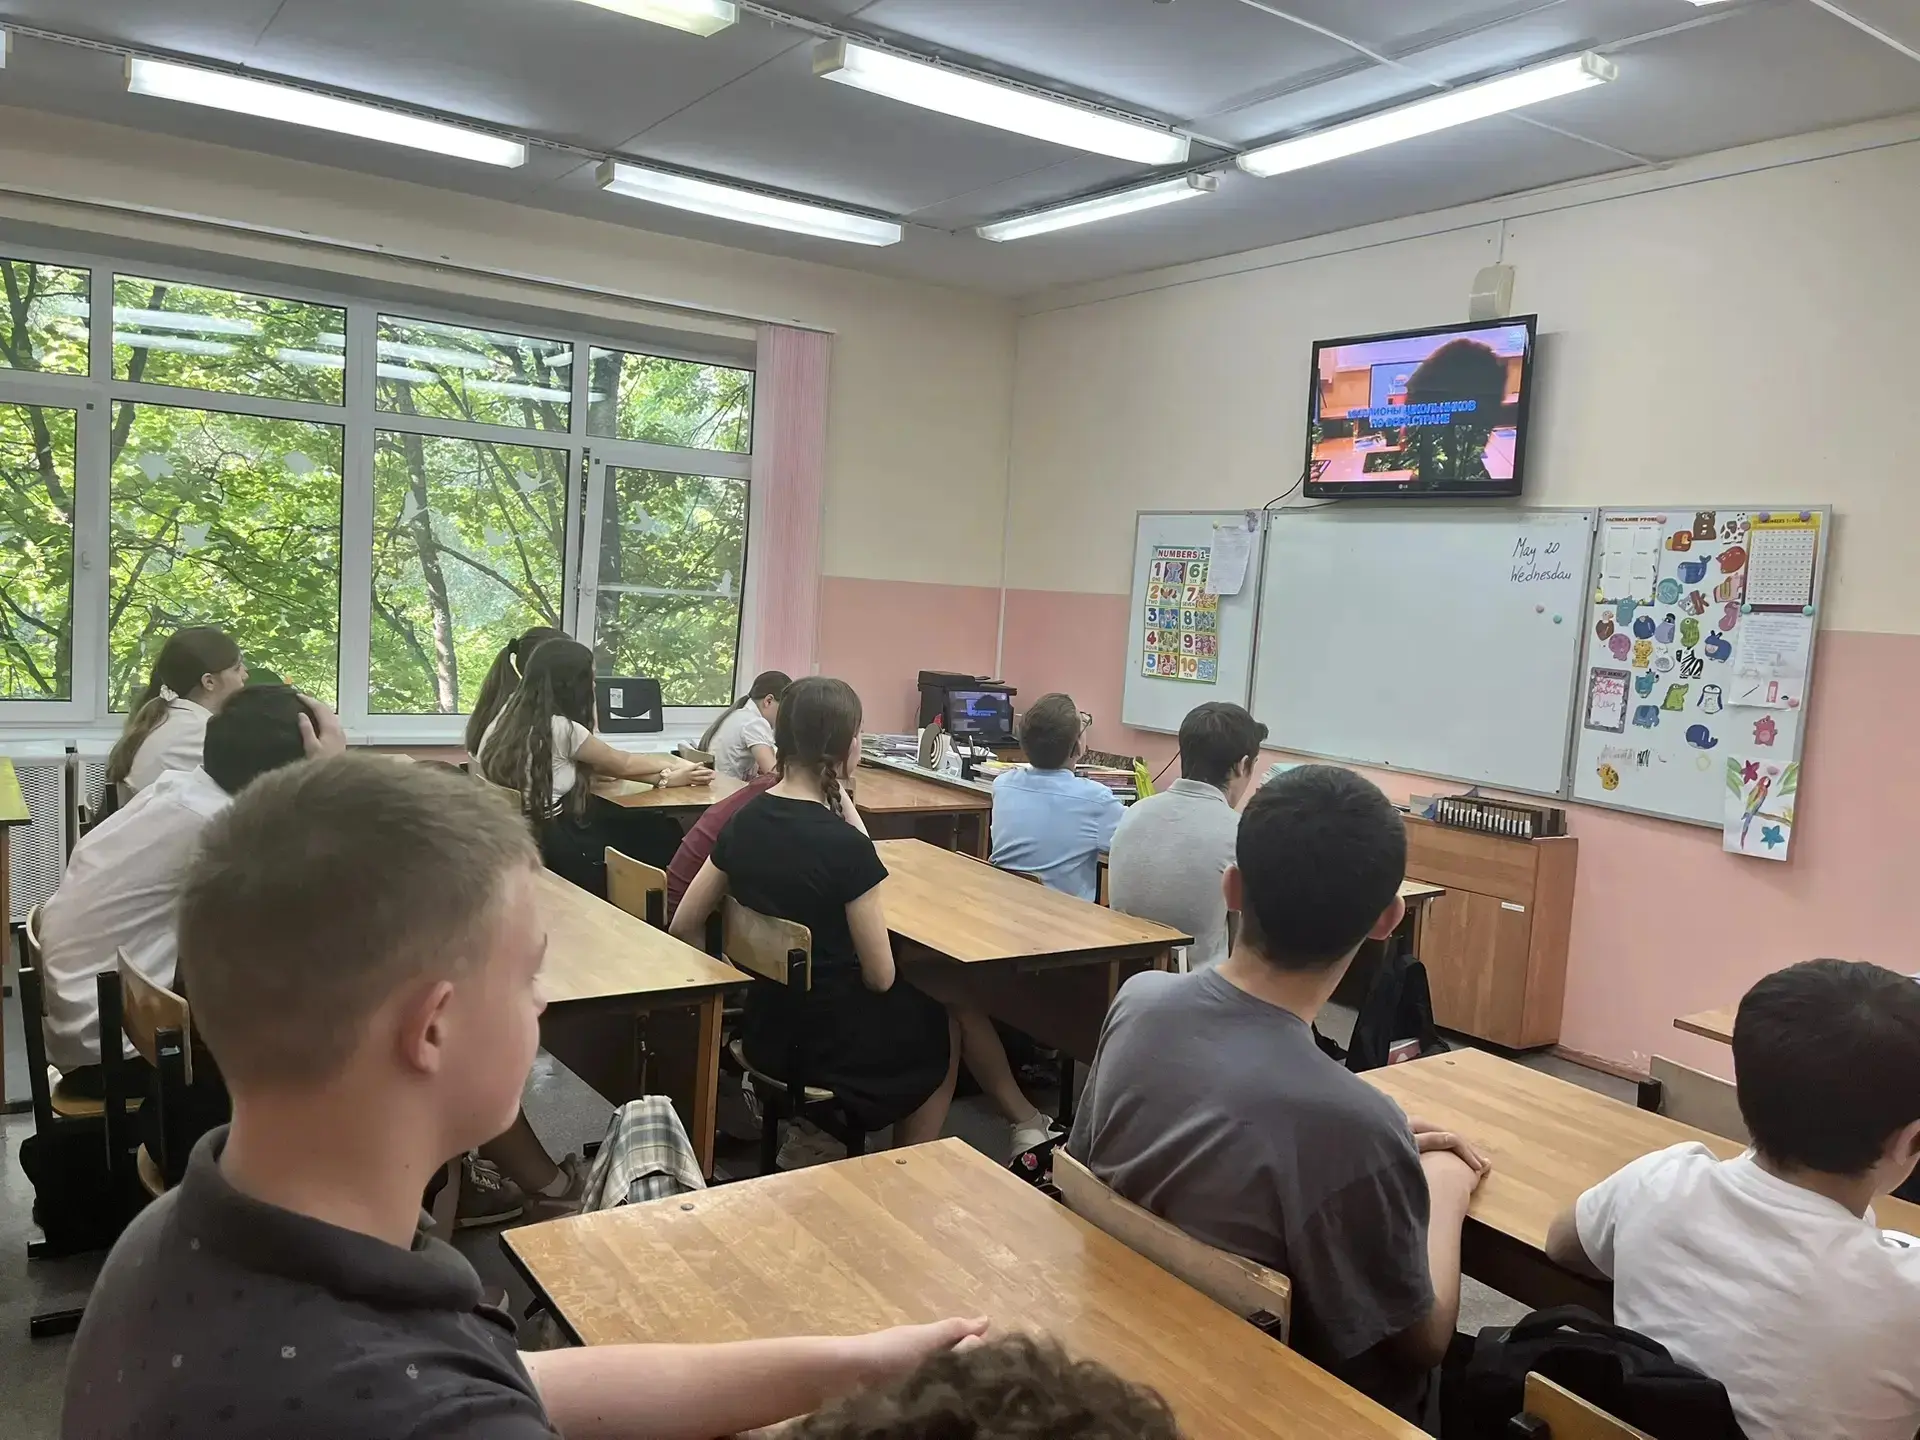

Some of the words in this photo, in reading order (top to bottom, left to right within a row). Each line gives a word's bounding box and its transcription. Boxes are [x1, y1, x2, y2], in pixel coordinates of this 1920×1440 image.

[1405, 400, 1477, 416] ШКОЛЬНИКОВ
[1410, 413, 1450, 426] СТРАНЕ
[1158, 550, 1198, 559] NUMBERS
[1512, 537, 1536, 566] May
[1544, 542, 1560, 554] 20
[1154, 562, 1161, 576] 1
[1189, 563, 1201, 578] 6
[1150, 584, 1160, 599] 2
[1187, 587, 1196, 601] 7
[1148, 608, 1157, 621] 3
[1184, 610, 1193, 625] 8
[1146, 631, 1156, 645] 4
[1183, 634, 1193, 648] 9
[1146, 653, 1156, 668] 5
[1181, 657, 1197, 673] 10
